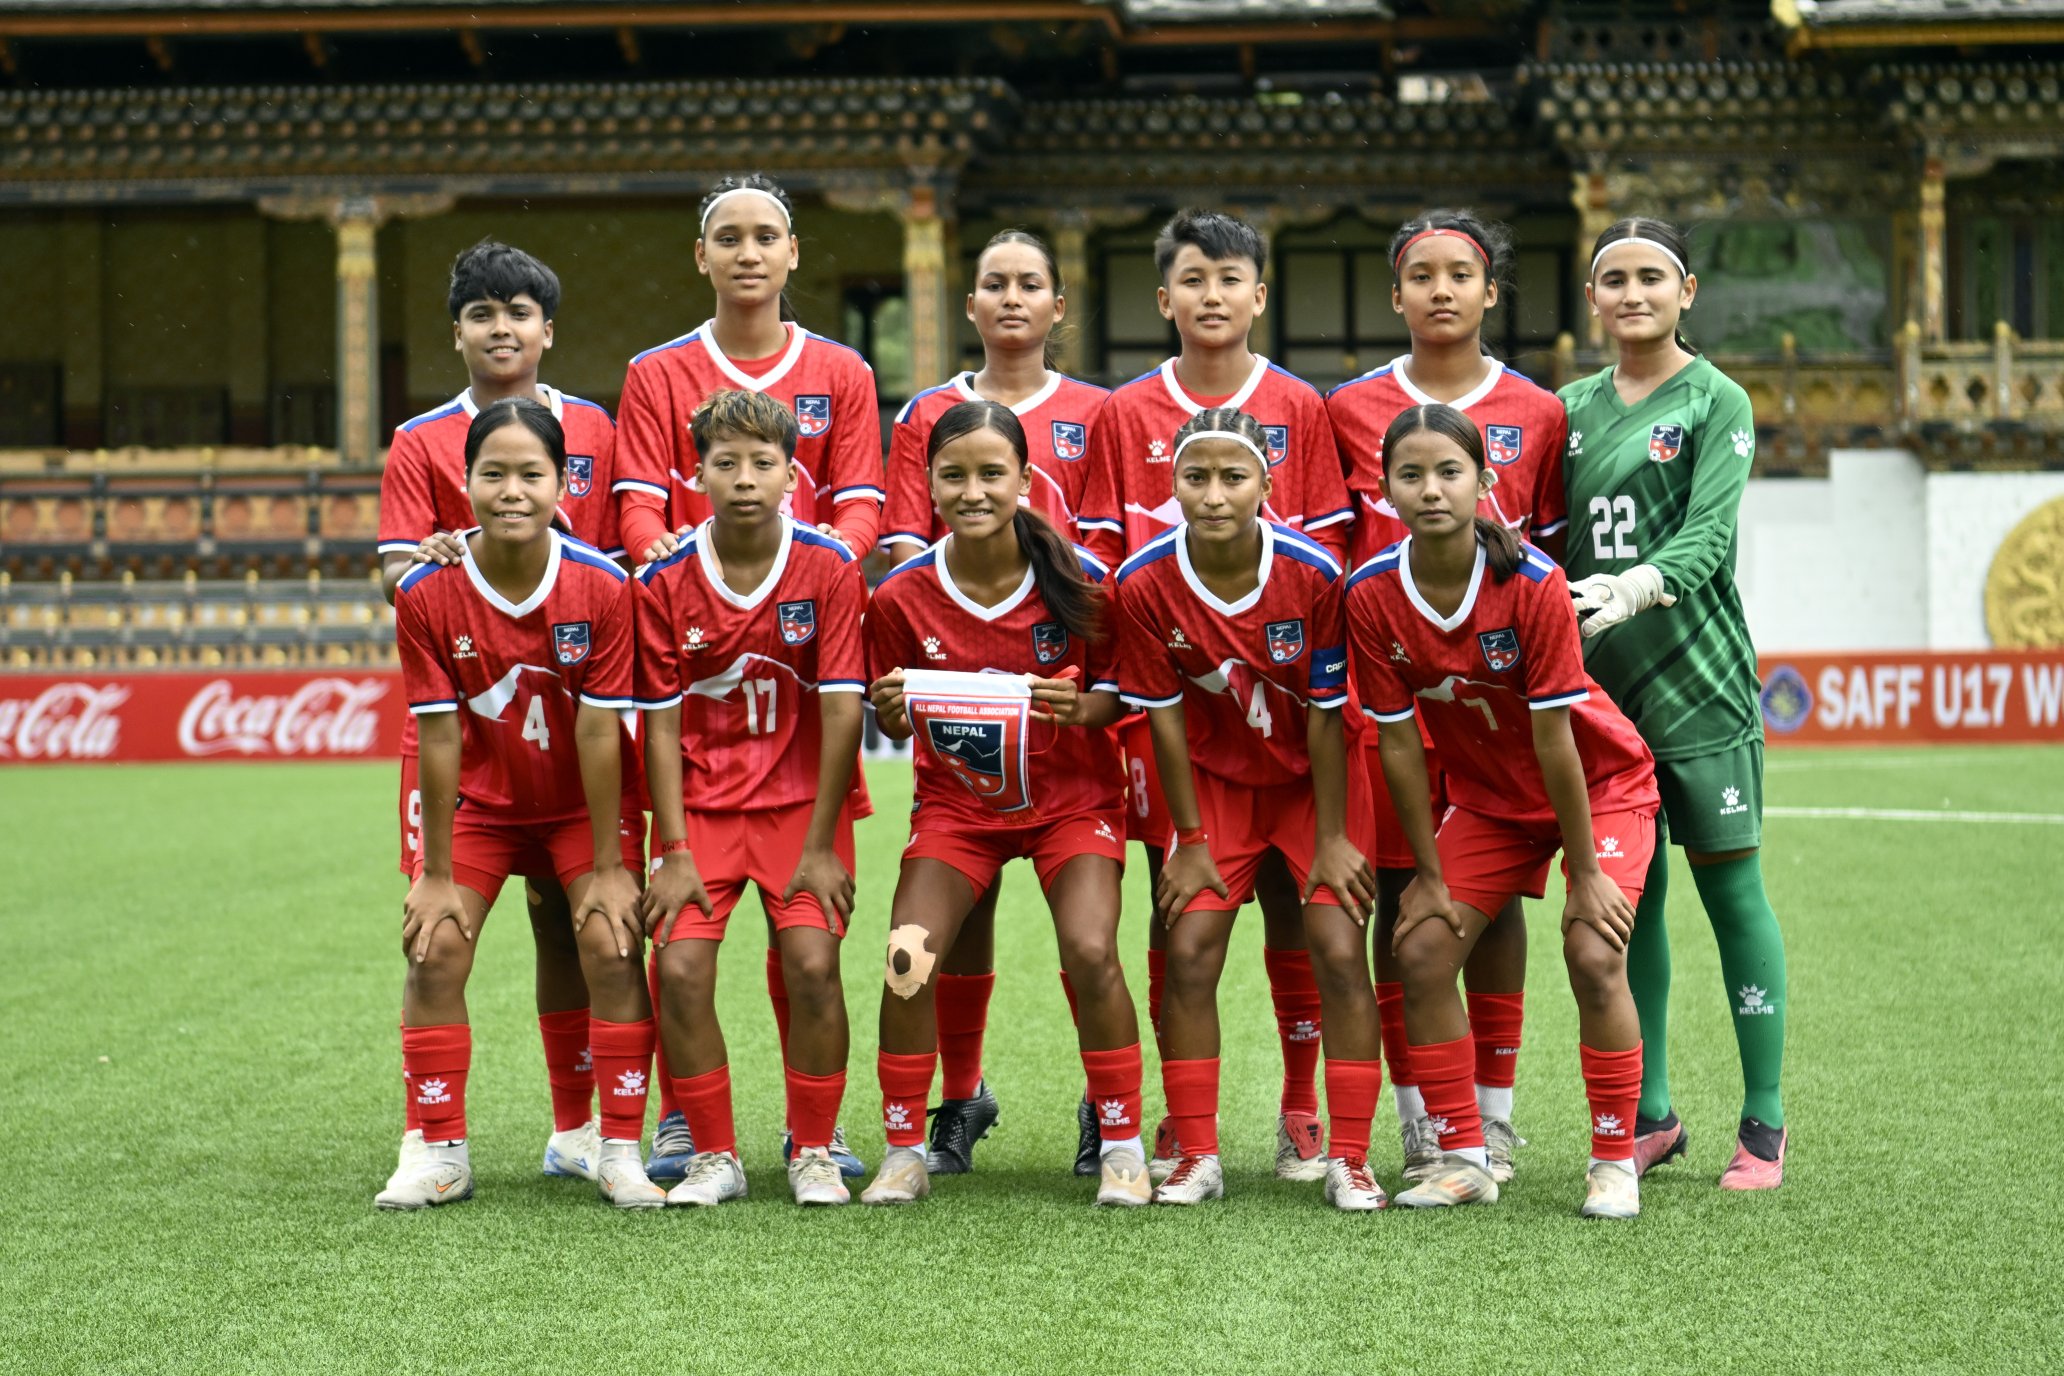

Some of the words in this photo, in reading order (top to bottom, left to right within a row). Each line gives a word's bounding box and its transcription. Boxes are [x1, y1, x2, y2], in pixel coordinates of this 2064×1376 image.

[1568, 448, 1583, 456] ELME
[1146, 455, 1171, 463] KELME
[1589, 495, 1638, 559] 22
[1817, 665, 1923, 729] SAFF
[1933, 664, 2013, 727] U17
[2021, 663, 2064, 727] W
[742, 678, 777, 735] 17
[915, 704, 926, 712] ALL
[927, 704, 946, 713] NEPAL
[947, 705, 978, 715] FOOTBALL
[979, 707, 1019, 716] ASSOCIATION
[1461, 697, 1499, 731] 7
[522, 695, 550, 751] 4
[943, 725, 987, 738] NEPAL
[1720, 804, 1747, 815] KELME
[1739, 1005, 1774, 1015] KELME
[1289, 1031, 1321, 1041] KELME
[417, 1094, 451, 1104] KELME
[885, 1121, 912, 1130] KELME
[1101, 1116, 1130, 1126] KELME
[1594, 1126, 1625, 1136] KELME
